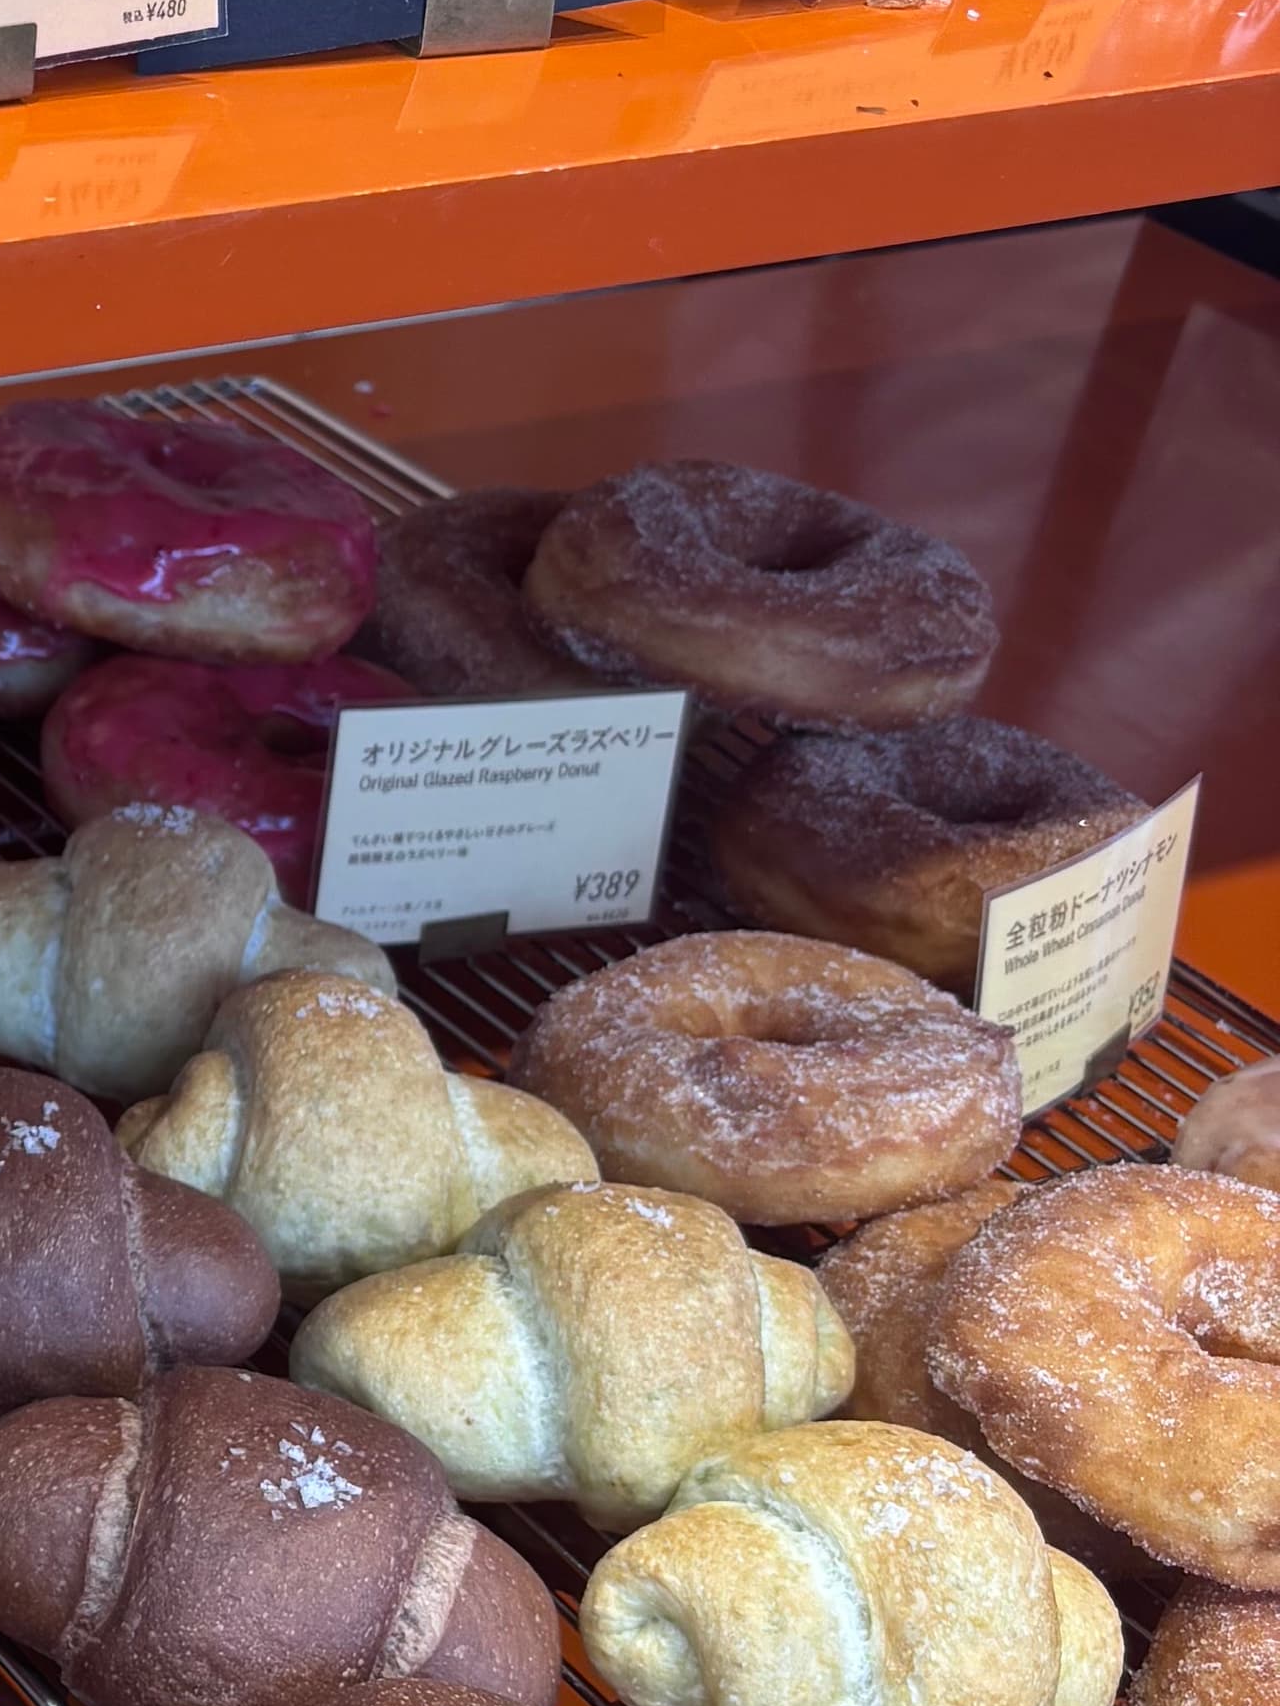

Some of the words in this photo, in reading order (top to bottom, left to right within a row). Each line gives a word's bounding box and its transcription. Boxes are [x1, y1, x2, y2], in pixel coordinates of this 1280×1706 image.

[360, 725, 674, 767] オリジナルグレーズラズベリー
[359, 773, 418, 793] Original
[423, 769, 474, 788] Glazed
[477, 764, 552, 786] Raspberry
[558, 761, 601, 779] Donut
[574, 869, 640, 903] ¥389
[1005, 833, 1177, 951] 全粒粉ドーナツシナモン
[1004, 950, 1039, 975] Whole
